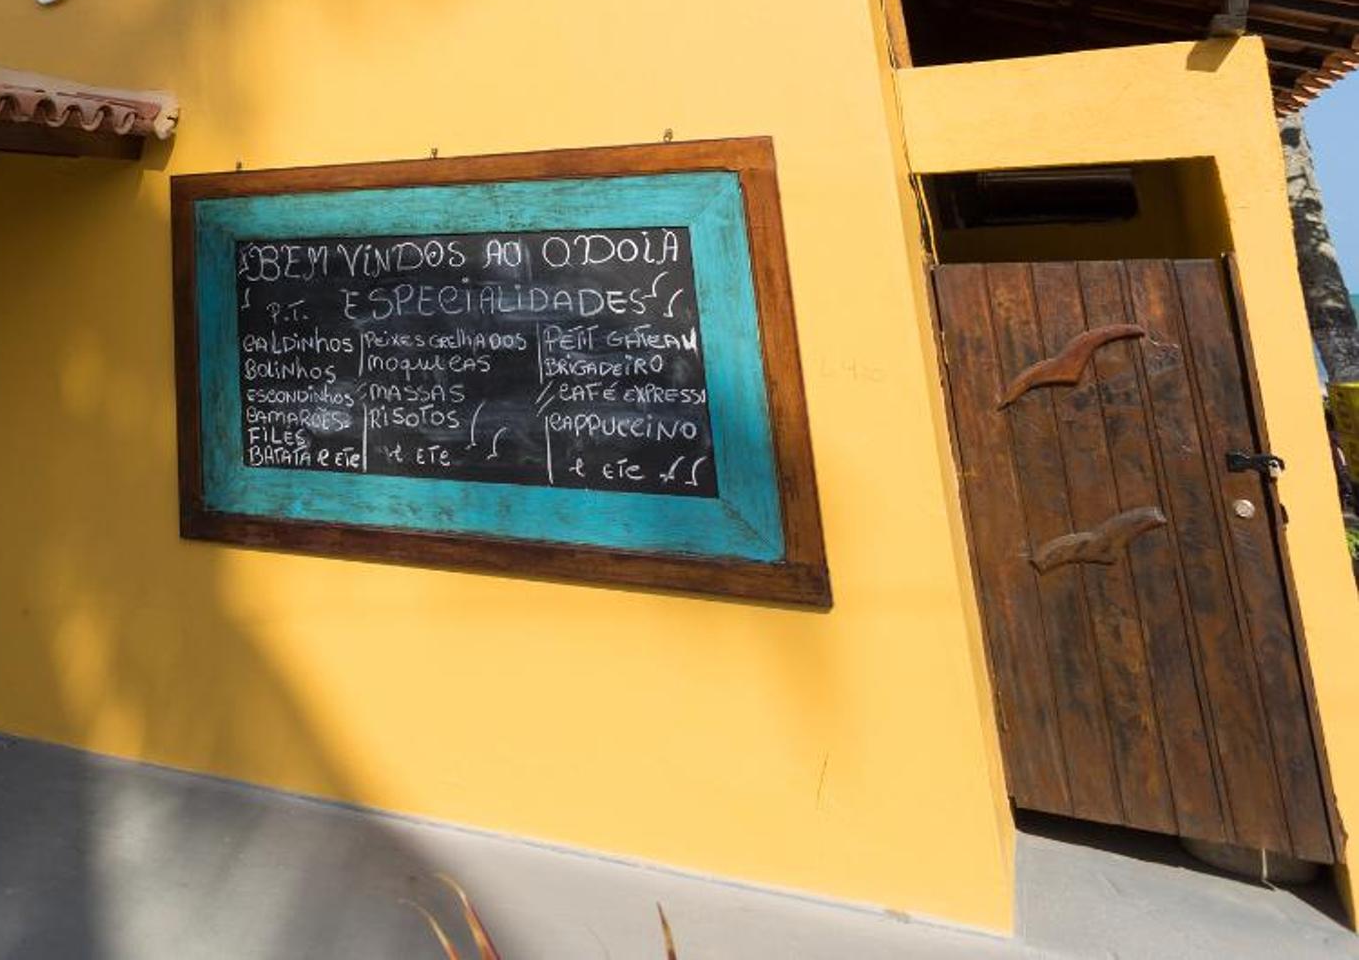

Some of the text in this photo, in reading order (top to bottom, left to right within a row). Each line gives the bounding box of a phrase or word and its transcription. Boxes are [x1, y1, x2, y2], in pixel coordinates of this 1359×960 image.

[246, 243, 328, 282] BEM
[482, 238, 522, 270] AO
[369, 382, 466, 403] MASSAS
[249, 444, 312, 467] BATATA
